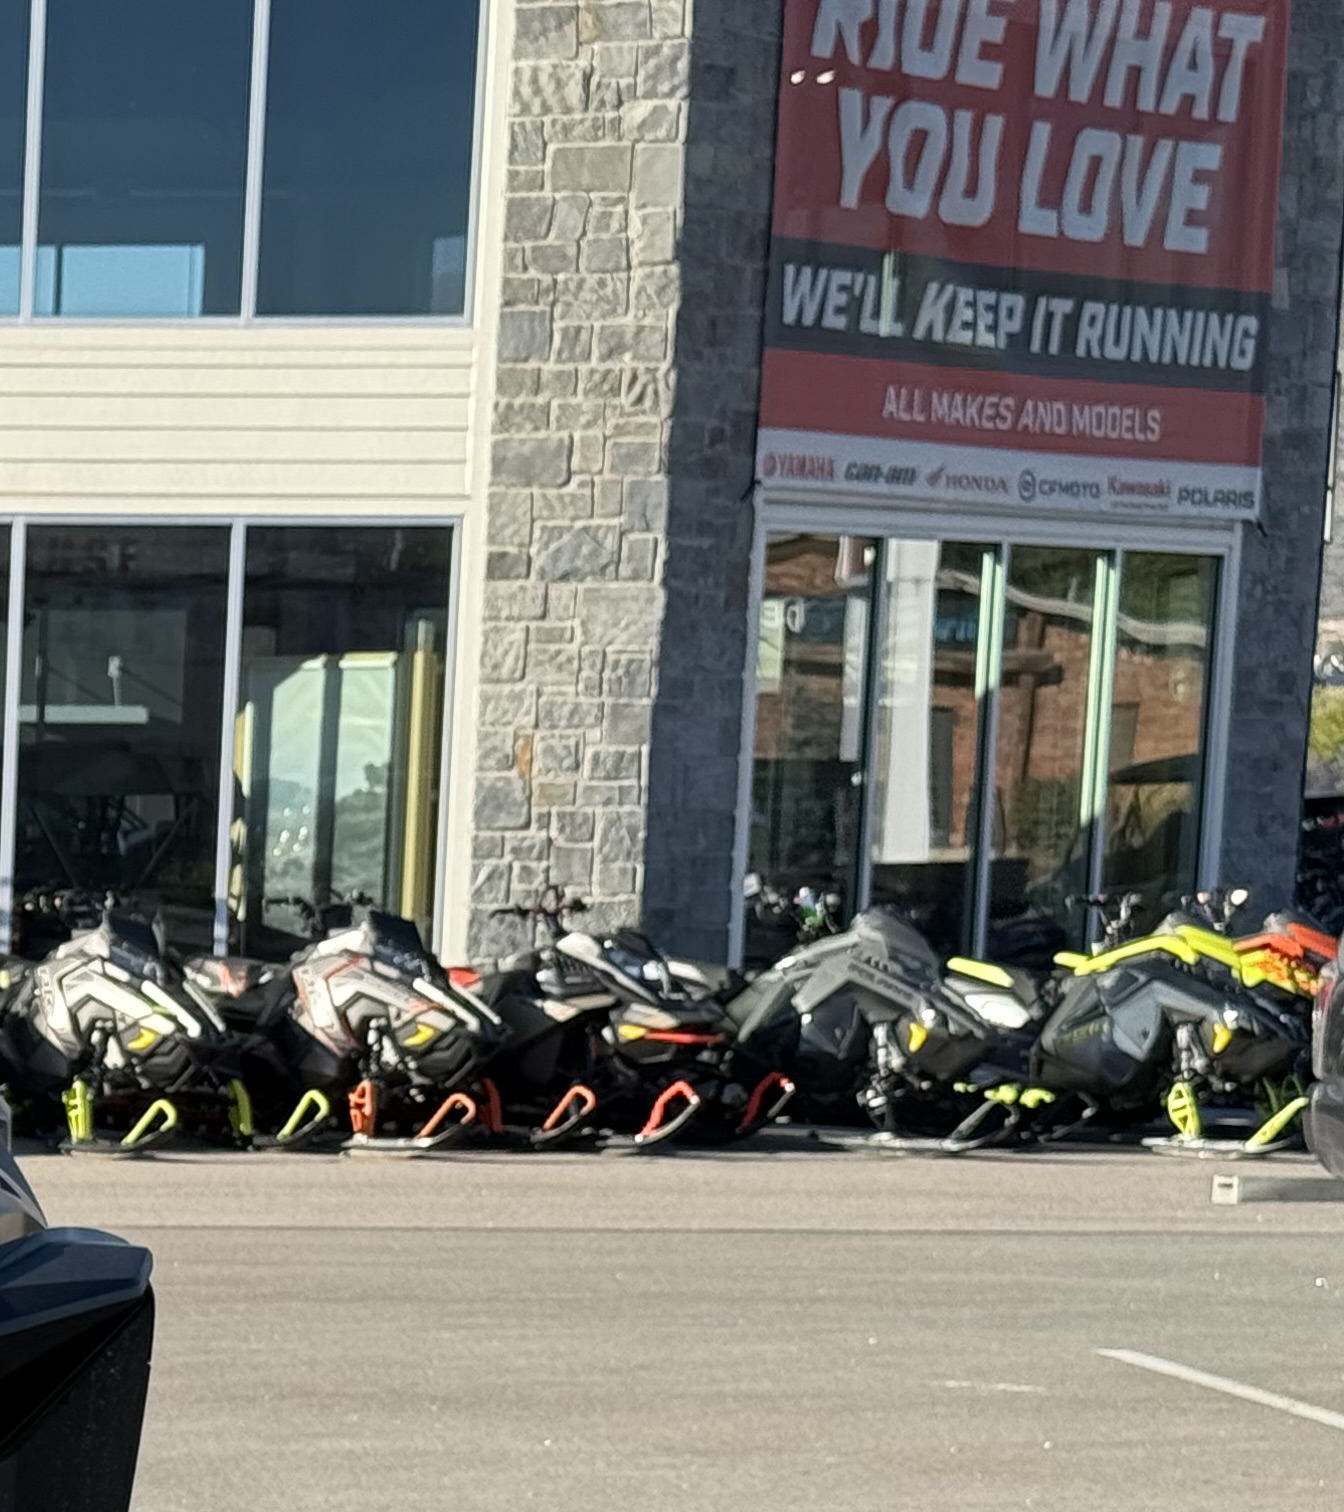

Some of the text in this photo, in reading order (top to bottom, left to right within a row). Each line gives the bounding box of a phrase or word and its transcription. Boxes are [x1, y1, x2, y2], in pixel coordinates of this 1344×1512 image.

[1034, 0, 1266, 123] WHAT
[838, 86, 1223, 254] YOU LOVE
[782, 262, 1259, 371] WE'LL KEEP IT RUNNING
[882, 384, 1162, 442] ALL MAKES AND MODELS
[778, 453, 834, 480] YAMAHA
[945, 473, 1010, 493] HONDA
[1038, 478, 1101, 499] CFMOTO
[1177, 486, 1256, 510] POLARIS
